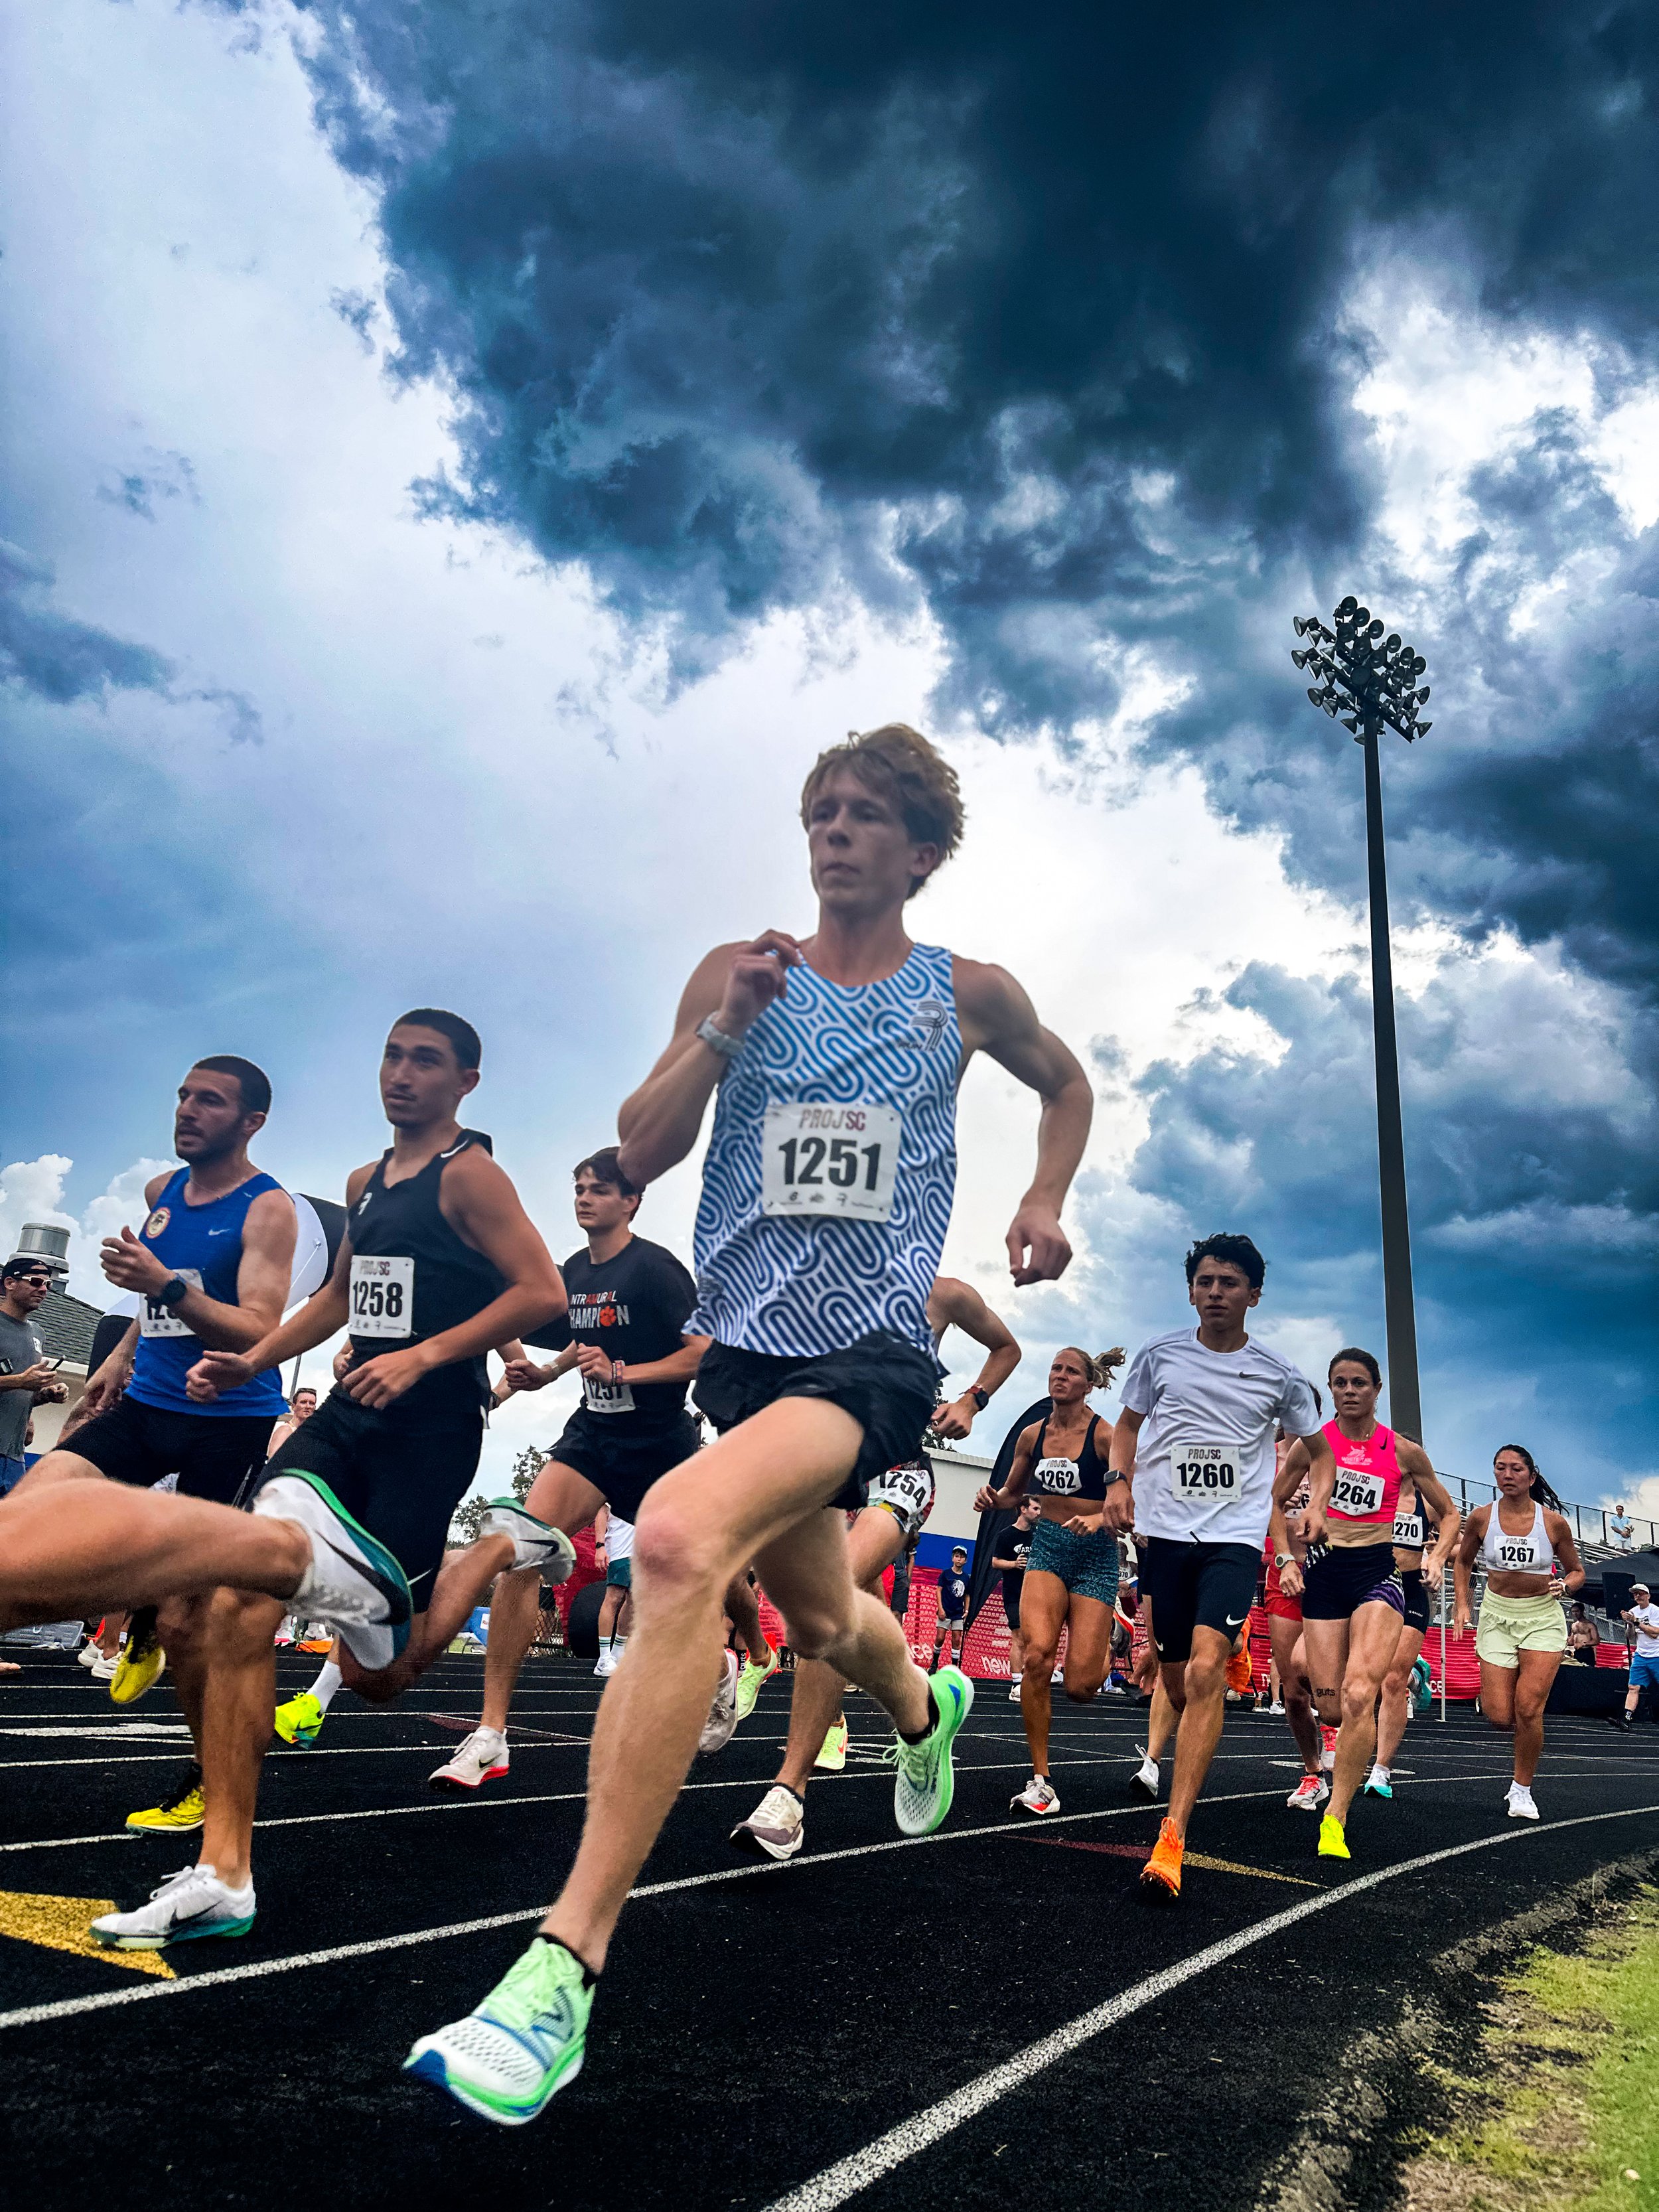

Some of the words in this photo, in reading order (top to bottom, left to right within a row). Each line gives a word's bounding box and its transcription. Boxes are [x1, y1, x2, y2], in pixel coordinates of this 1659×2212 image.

[799, 1109, 866, 1131] PROJSC
[778, 1137, 881, 1191] 1251
[353, 1281, 403, 1318] 1258
[571, 1290, 617, 1305] NTRAMURAL
[568, 1305, 630, 1329] HAMPIN
[1188, 1449, 1222, 1460] PROJSC
[1039, 1470, 1076, 1489] 1262
[1177, 1463, 1235, 1489] 1260
[1342, 1470, 1370, 1485] PROJSC
[879, 1471, 927, 1509] 1254
[1331, 1479, 1376, 1510] 1264
[1506, 1537, 1528, 1546] PROJSC
[1499, 1546, 1534, 1563] 1267
[981, 1656, 1011, 1676] new
